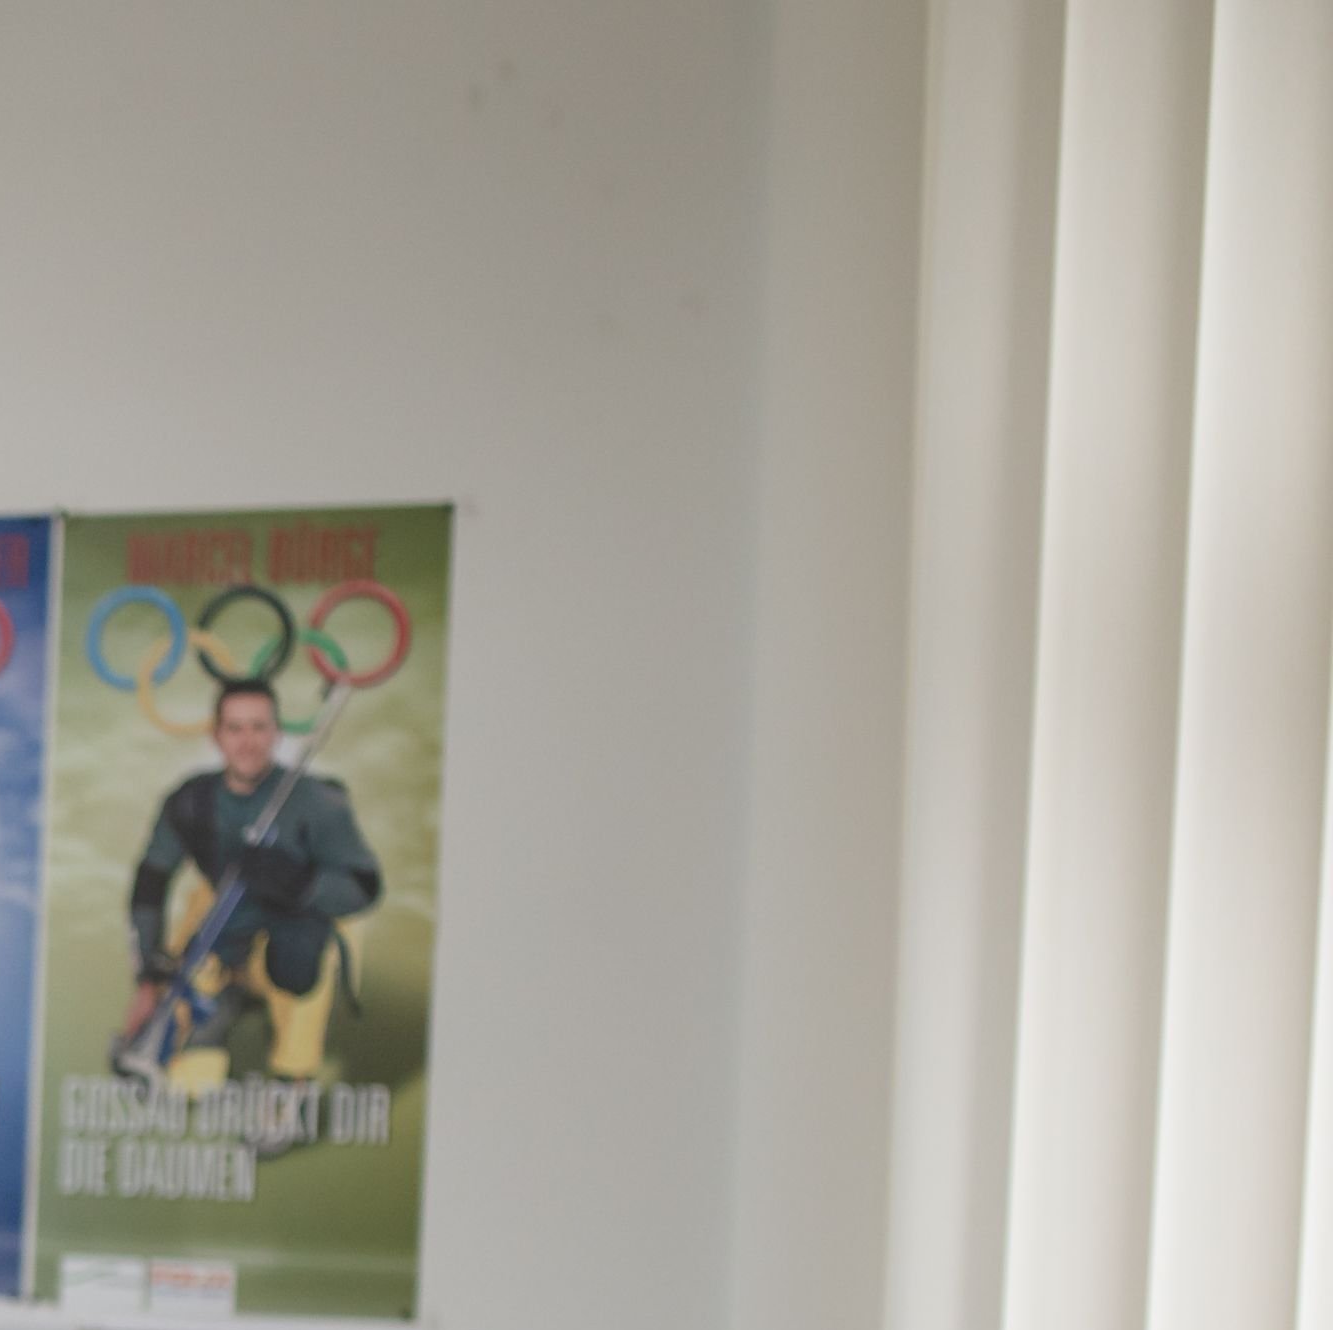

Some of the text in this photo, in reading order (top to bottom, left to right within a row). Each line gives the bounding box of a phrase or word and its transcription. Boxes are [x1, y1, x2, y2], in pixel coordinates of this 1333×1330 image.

[329, 1081, 391, 1145] DIR
[58, 1139, 258, 1201] DIE DAUMEN
